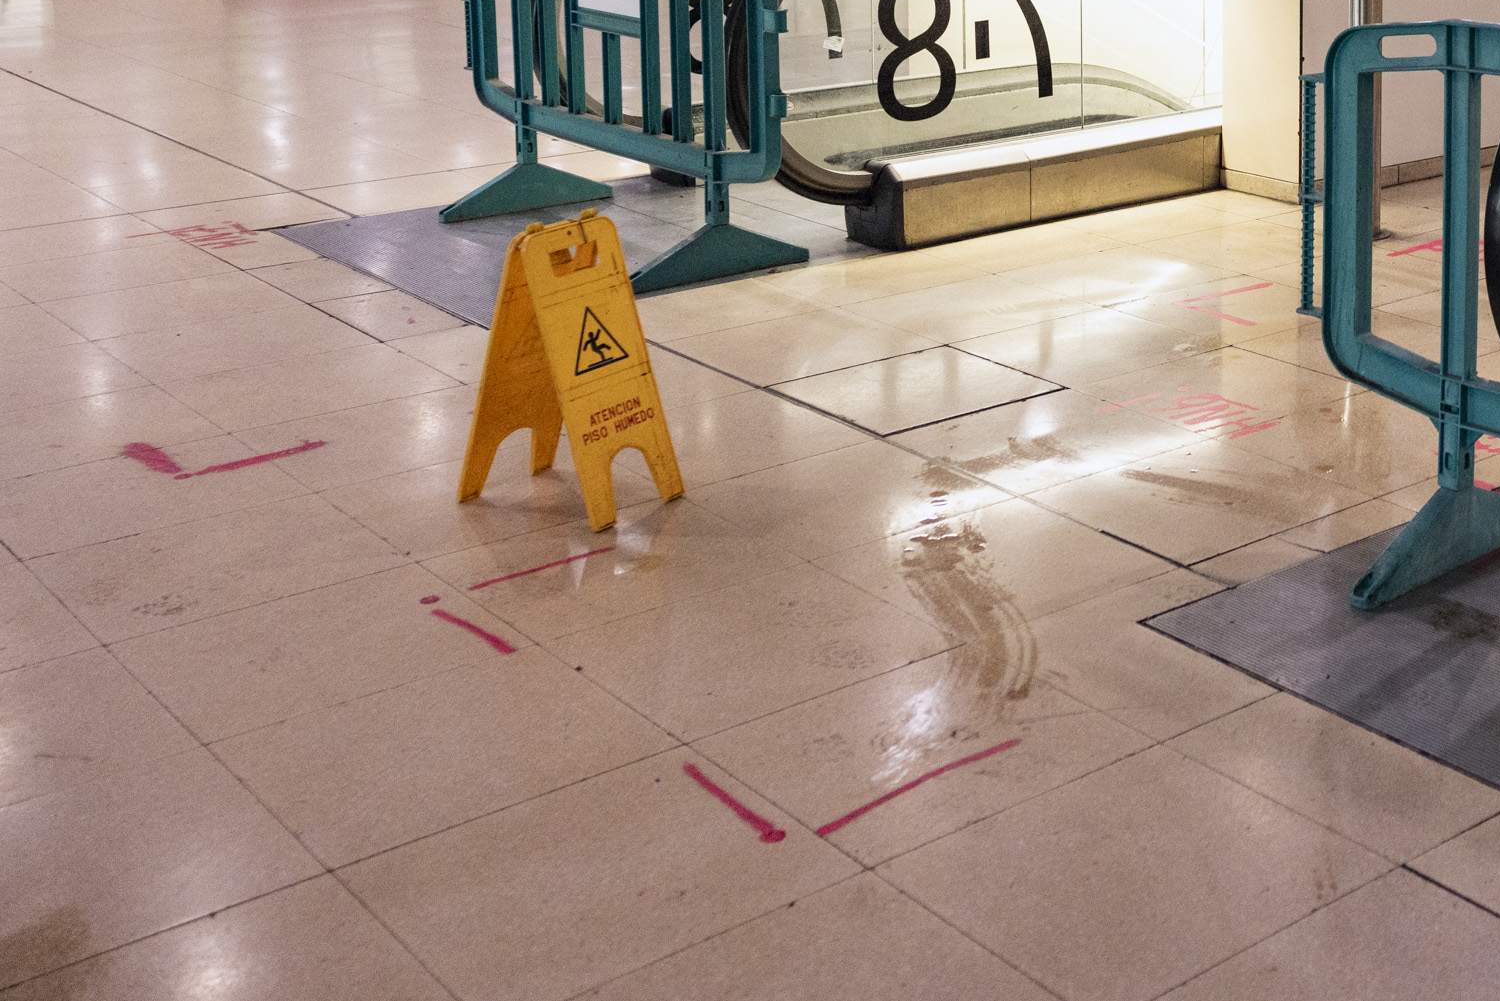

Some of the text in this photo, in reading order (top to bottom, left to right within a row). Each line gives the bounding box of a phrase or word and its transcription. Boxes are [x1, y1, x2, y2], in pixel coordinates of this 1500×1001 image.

[582, 407, 655, 446] PISO HUMEDO
[590, 396, 641, 427] ATENCION
